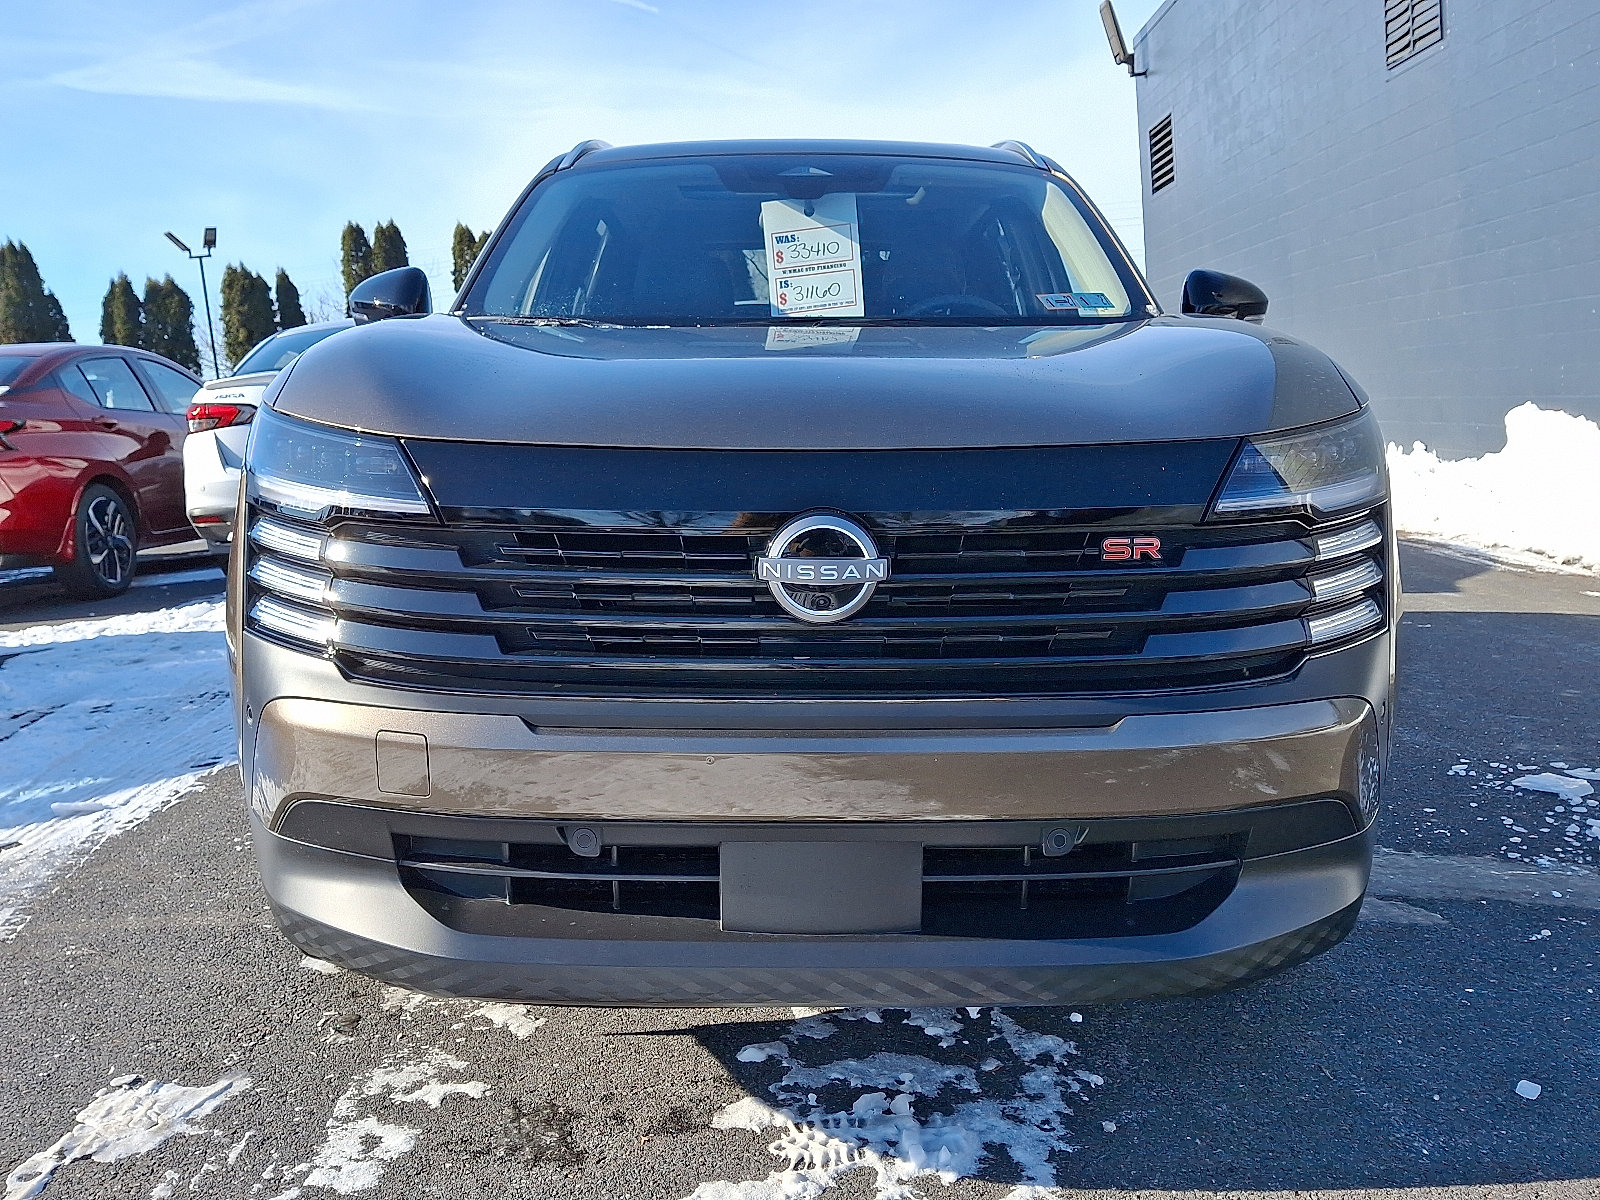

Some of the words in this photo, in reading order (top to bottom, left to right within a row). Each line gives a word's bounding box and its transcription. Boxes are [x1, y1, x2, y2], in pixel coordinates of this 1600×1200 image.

[775, 234, 800, 244] WAS:
[775, 250, 784, 264] $
[787, 241, 840, 259] 33410
[817, 262, 847, 271] FINANCING
[779, 280, 793, 289] IS:
[779, 292, 787, 306] $
[793, 282, 841, 301] 31160
[1102, 537, 1162, 560] SR
[762, 562, 885, 581] NISSAN
